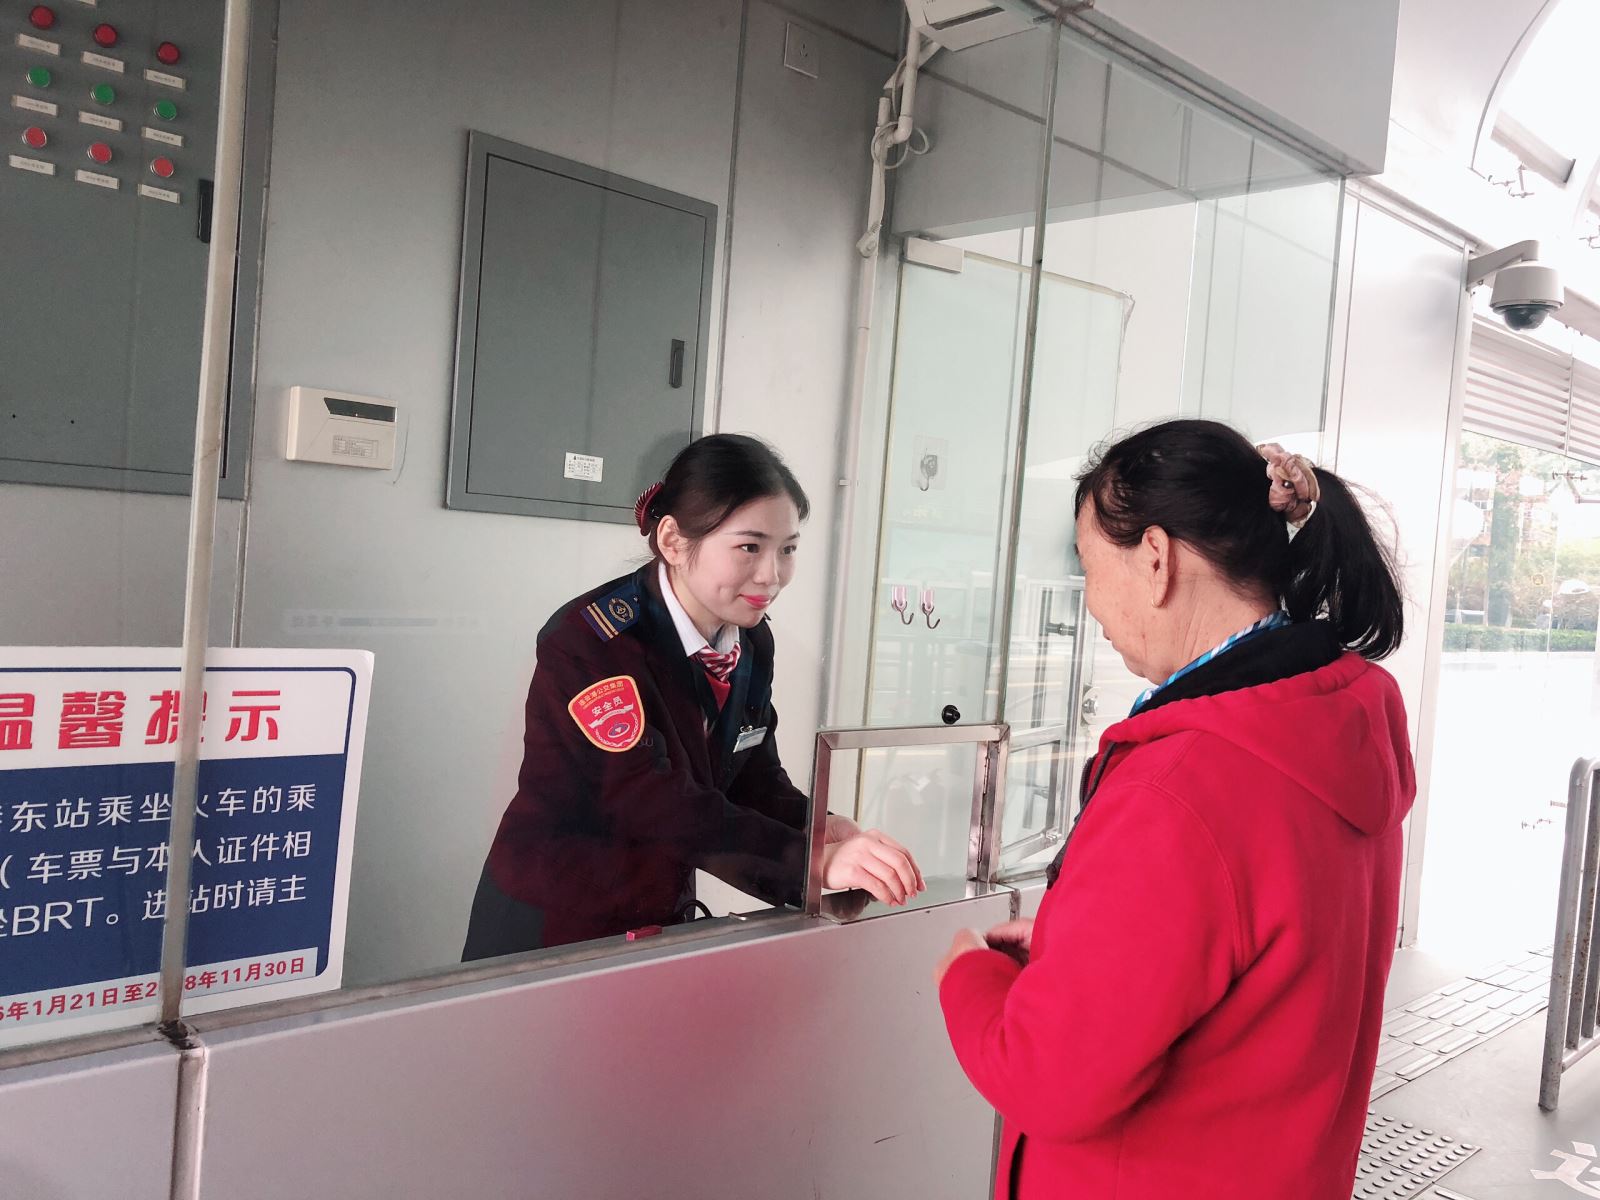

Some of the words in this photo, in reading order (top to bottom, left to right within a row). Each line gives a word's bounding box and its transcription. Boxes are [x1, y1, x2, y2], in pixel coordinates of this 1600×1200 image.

[592, 696, 624, 717] 安全员
[0, 783, 317, 833] 东站乘坐车的乘
[0, 957, 305, 1021] 年1月21日至28年11月30日
